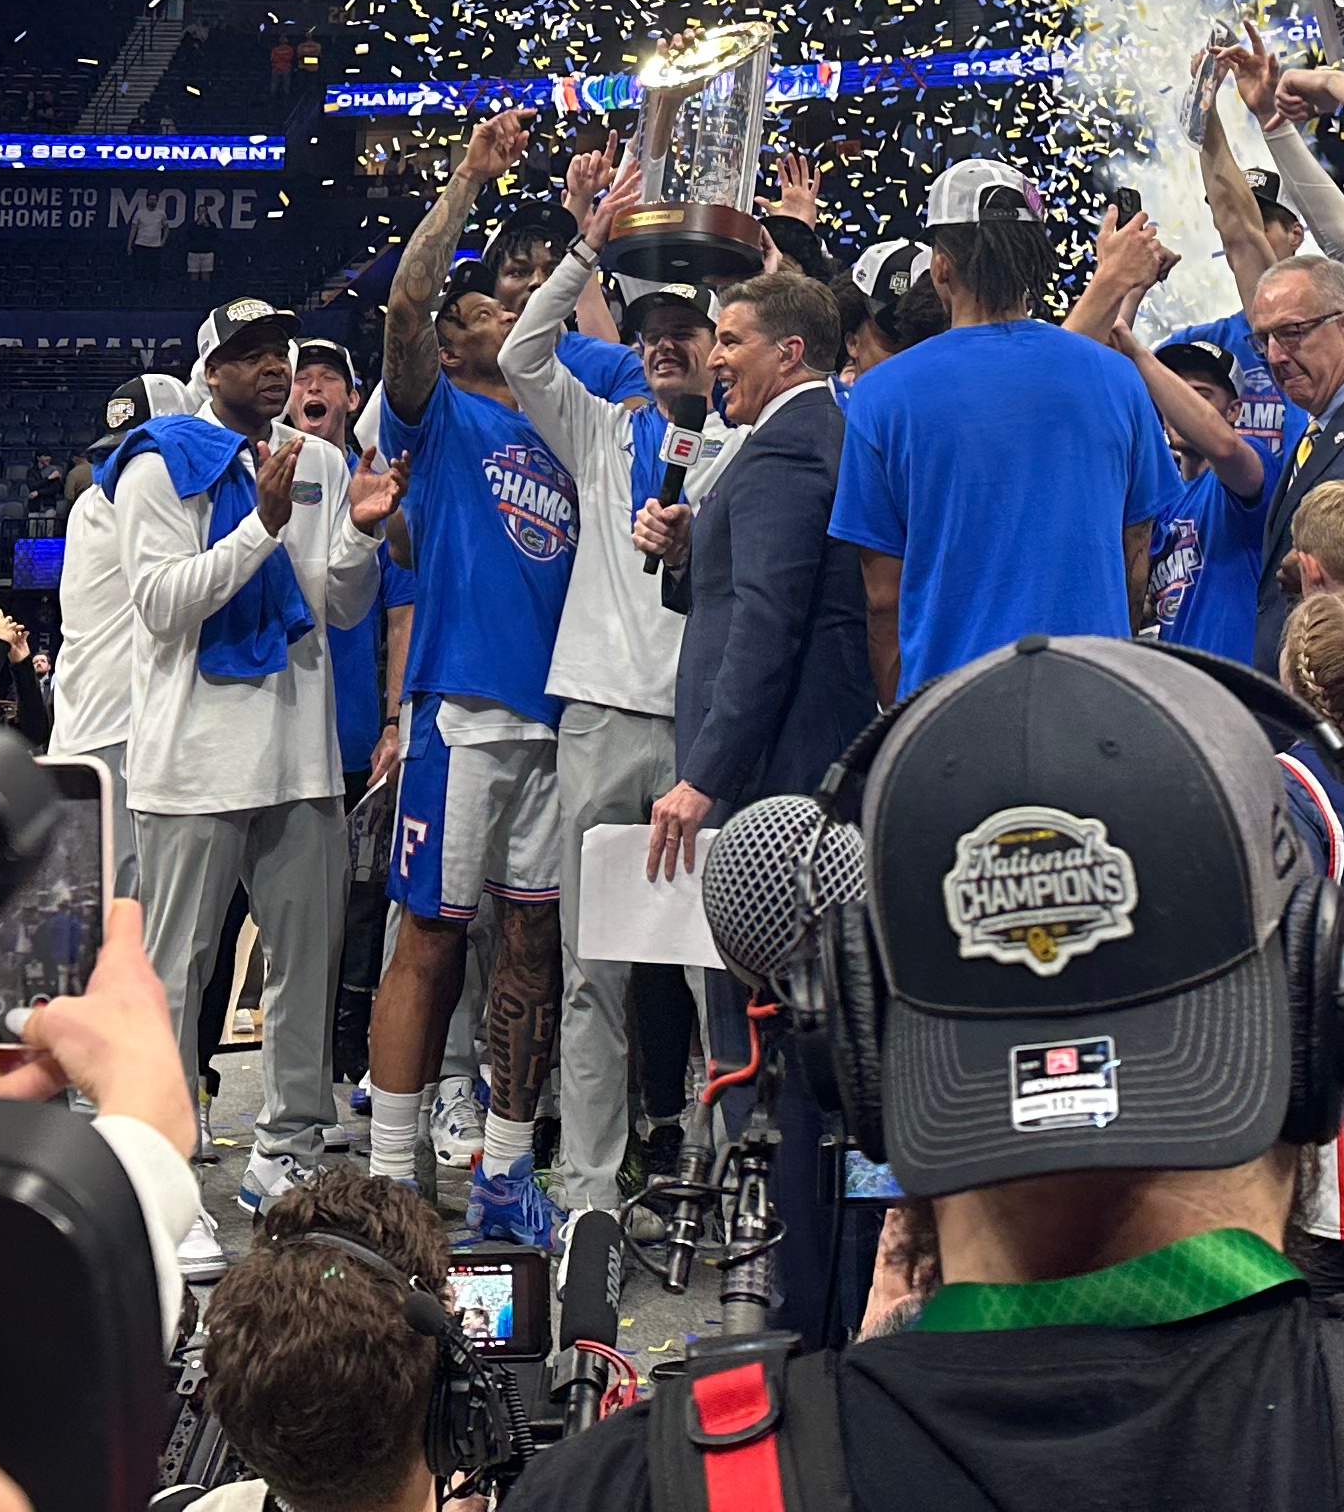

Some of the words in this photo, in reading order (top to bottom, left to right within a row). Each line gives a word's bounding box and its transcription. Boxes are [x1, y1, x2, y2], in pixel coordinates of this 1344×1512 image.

[31, 143, 86, 159] SEC
[95, 144, 286, 161] TOURNAMENT
[70, 187, 97, 208] TO
[106, 189, 257, 230] MORE
[0, 208, 67, 229] HOME
[72, 209, 97, 229] OF
[399, 814, 429, 879] F
[965, 830, 1096, 880] National
[957, 862, 1127, 922] CHAMPIONS
